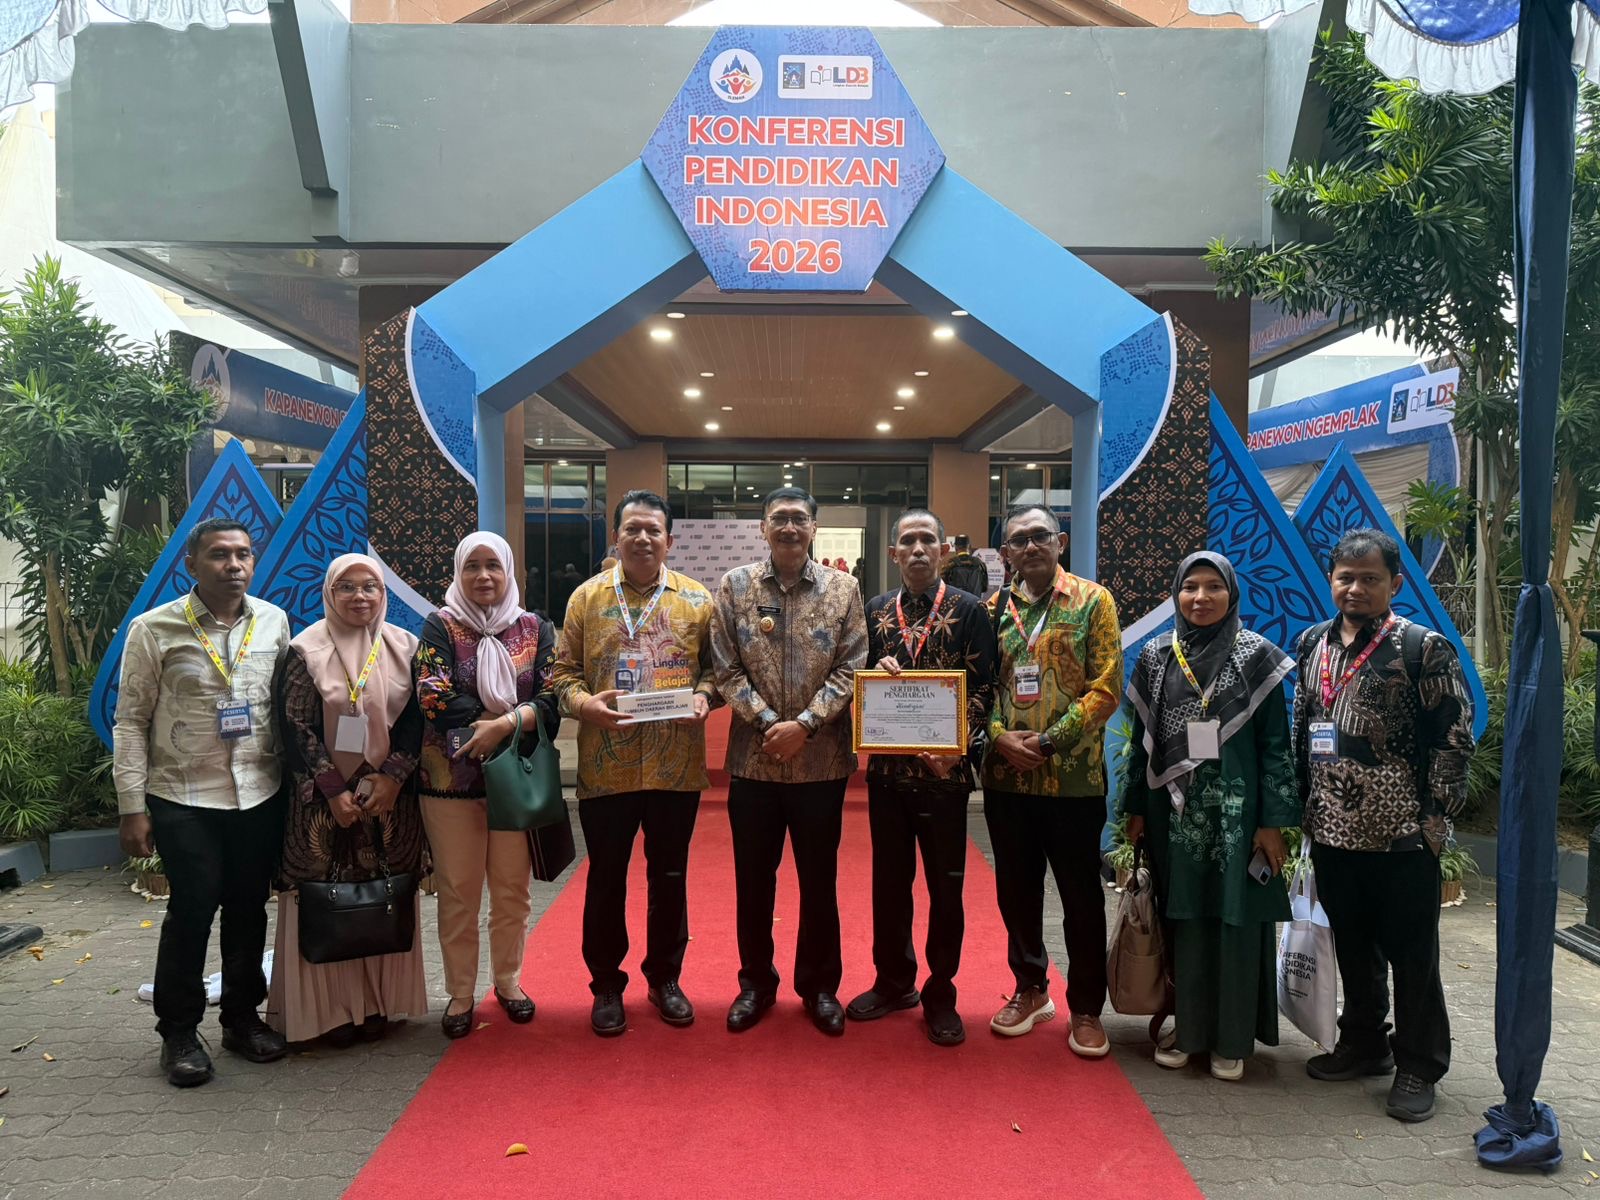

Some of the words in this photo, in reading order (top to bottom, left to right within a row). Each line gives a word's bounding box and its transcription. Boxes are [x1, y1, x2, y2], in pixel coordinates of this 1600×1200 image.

[687, 115, 905, 147] KONFERENSI
[684, 156, 899, 187] PENDIDIKAN
[695, 197, 888, 228] INDONESIA
[748, 239, 842, 273] 2026
[264, 387, 340, 429] KAPANEWON
[1303, 400, 1382, 440] NGEMPLAK
